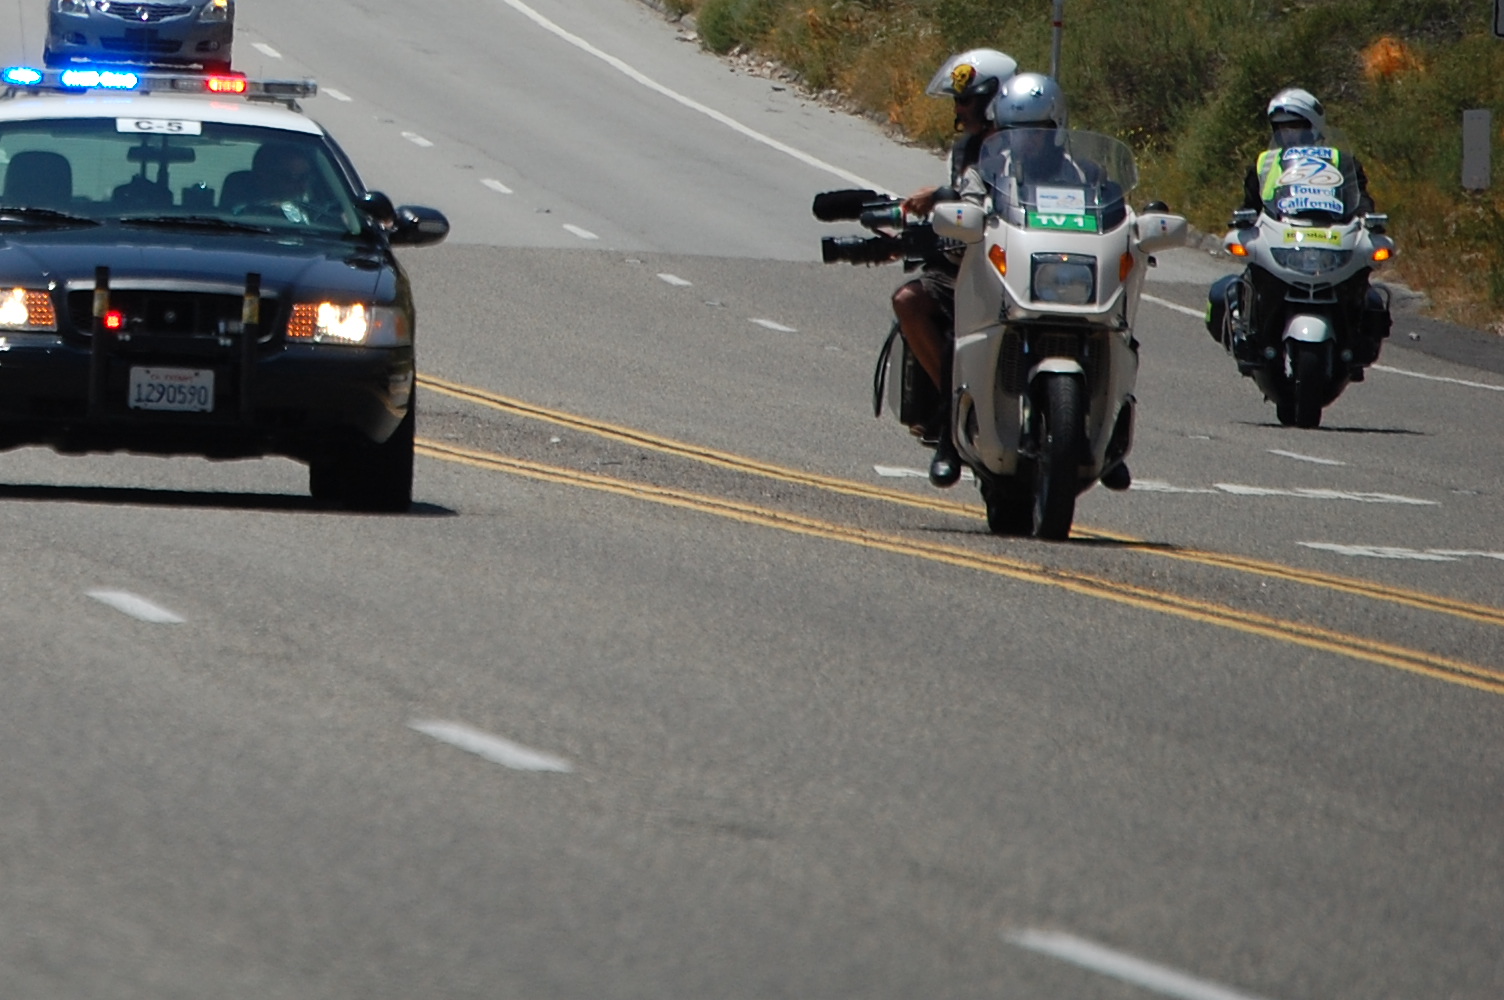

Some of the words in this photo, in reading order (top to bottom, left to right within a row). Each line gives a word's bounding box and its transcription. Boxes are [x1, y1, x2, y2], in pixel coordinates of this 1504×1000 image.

[134, 120, 184, 133] C-5
[1285, 148, 1332, 158] AMGEN
[1294, 185, 1321, 195] Tour
[1278, 198, 1342, 212] California
[1036, 214, 1067, 226] TV
[1073, 217, 1084, 227] 1
[134, 383, 209, 406] 1290590
